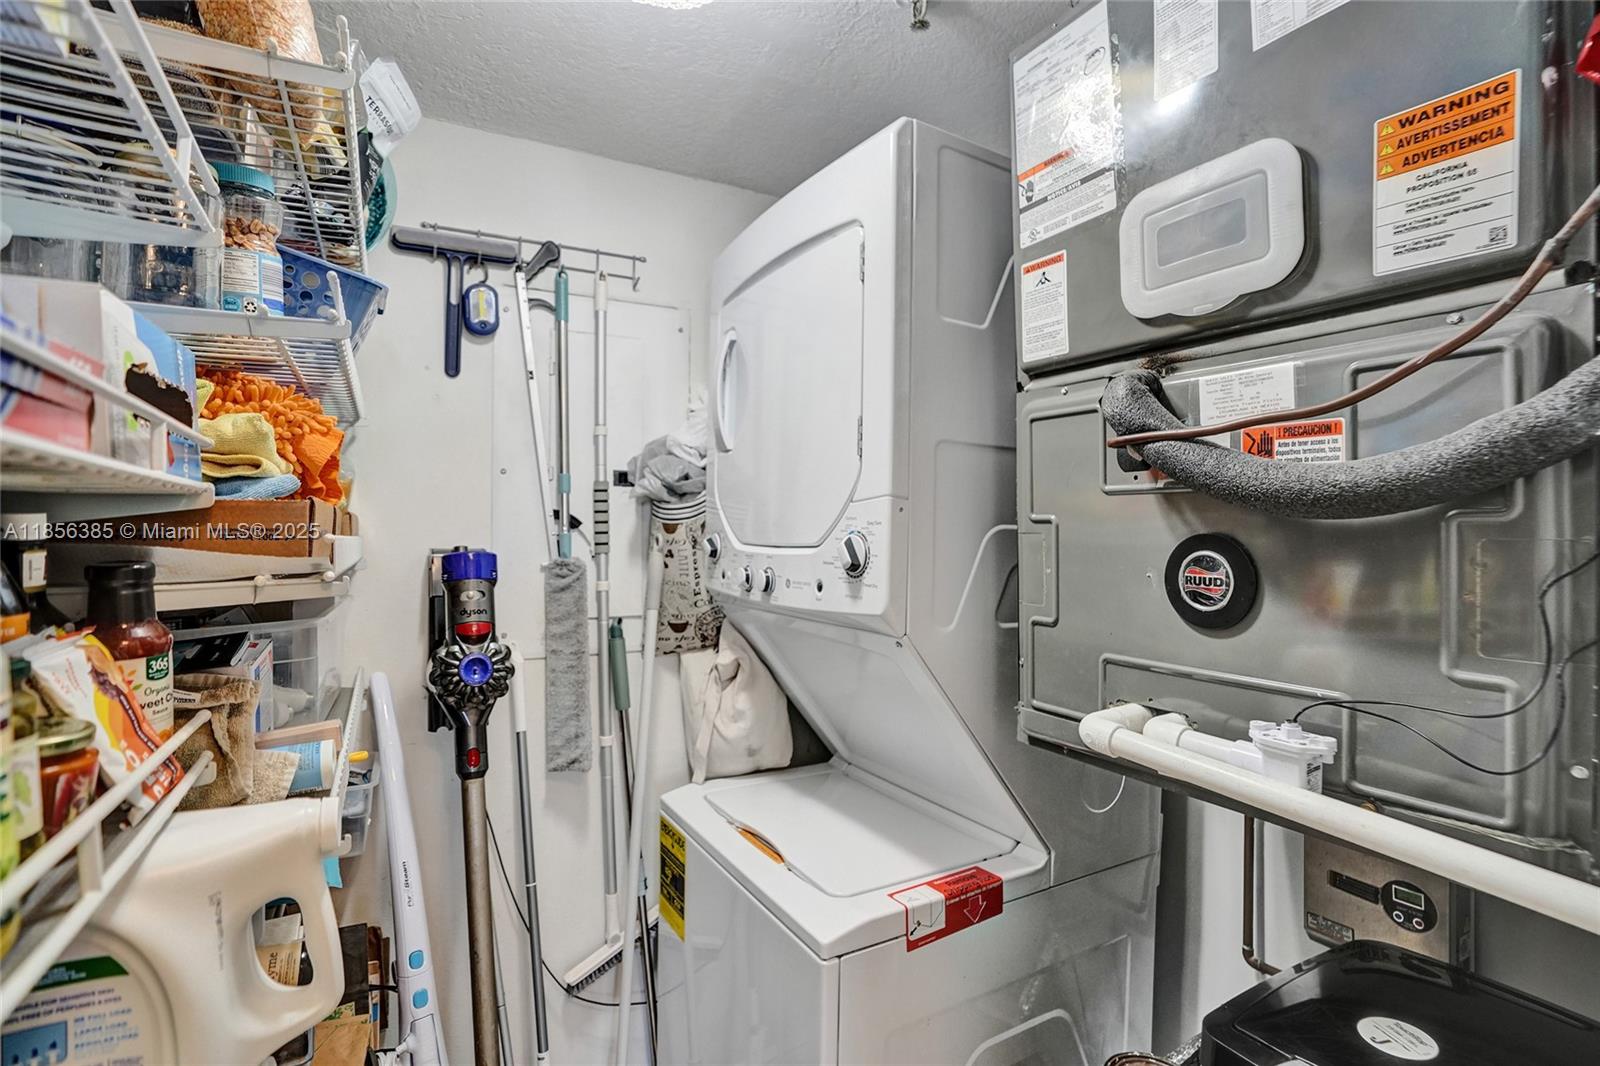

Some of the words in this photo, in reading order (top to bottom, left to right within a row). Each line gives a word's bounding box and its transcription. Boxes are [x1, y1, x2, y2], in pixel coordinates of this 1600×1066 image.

[1398, 81, 1510, 129] WARNING
[1397, 101, 1510, 150] AVERTISSEMENT
[1402, 126, 1504, 167] ADVERTENCIA
[1416, 162, 1468, 181] CALIFORNIA
[1406, 172, 1464, 194] PROPOSITION
[1283, 424, 1332, 437] PRECAUCION
[1185, 575, 1225, 588] RUUD
[460, 607, 488, 618] dyson
[149, 657, 168, 673] 365
[267, 951, 278, 980] yme
